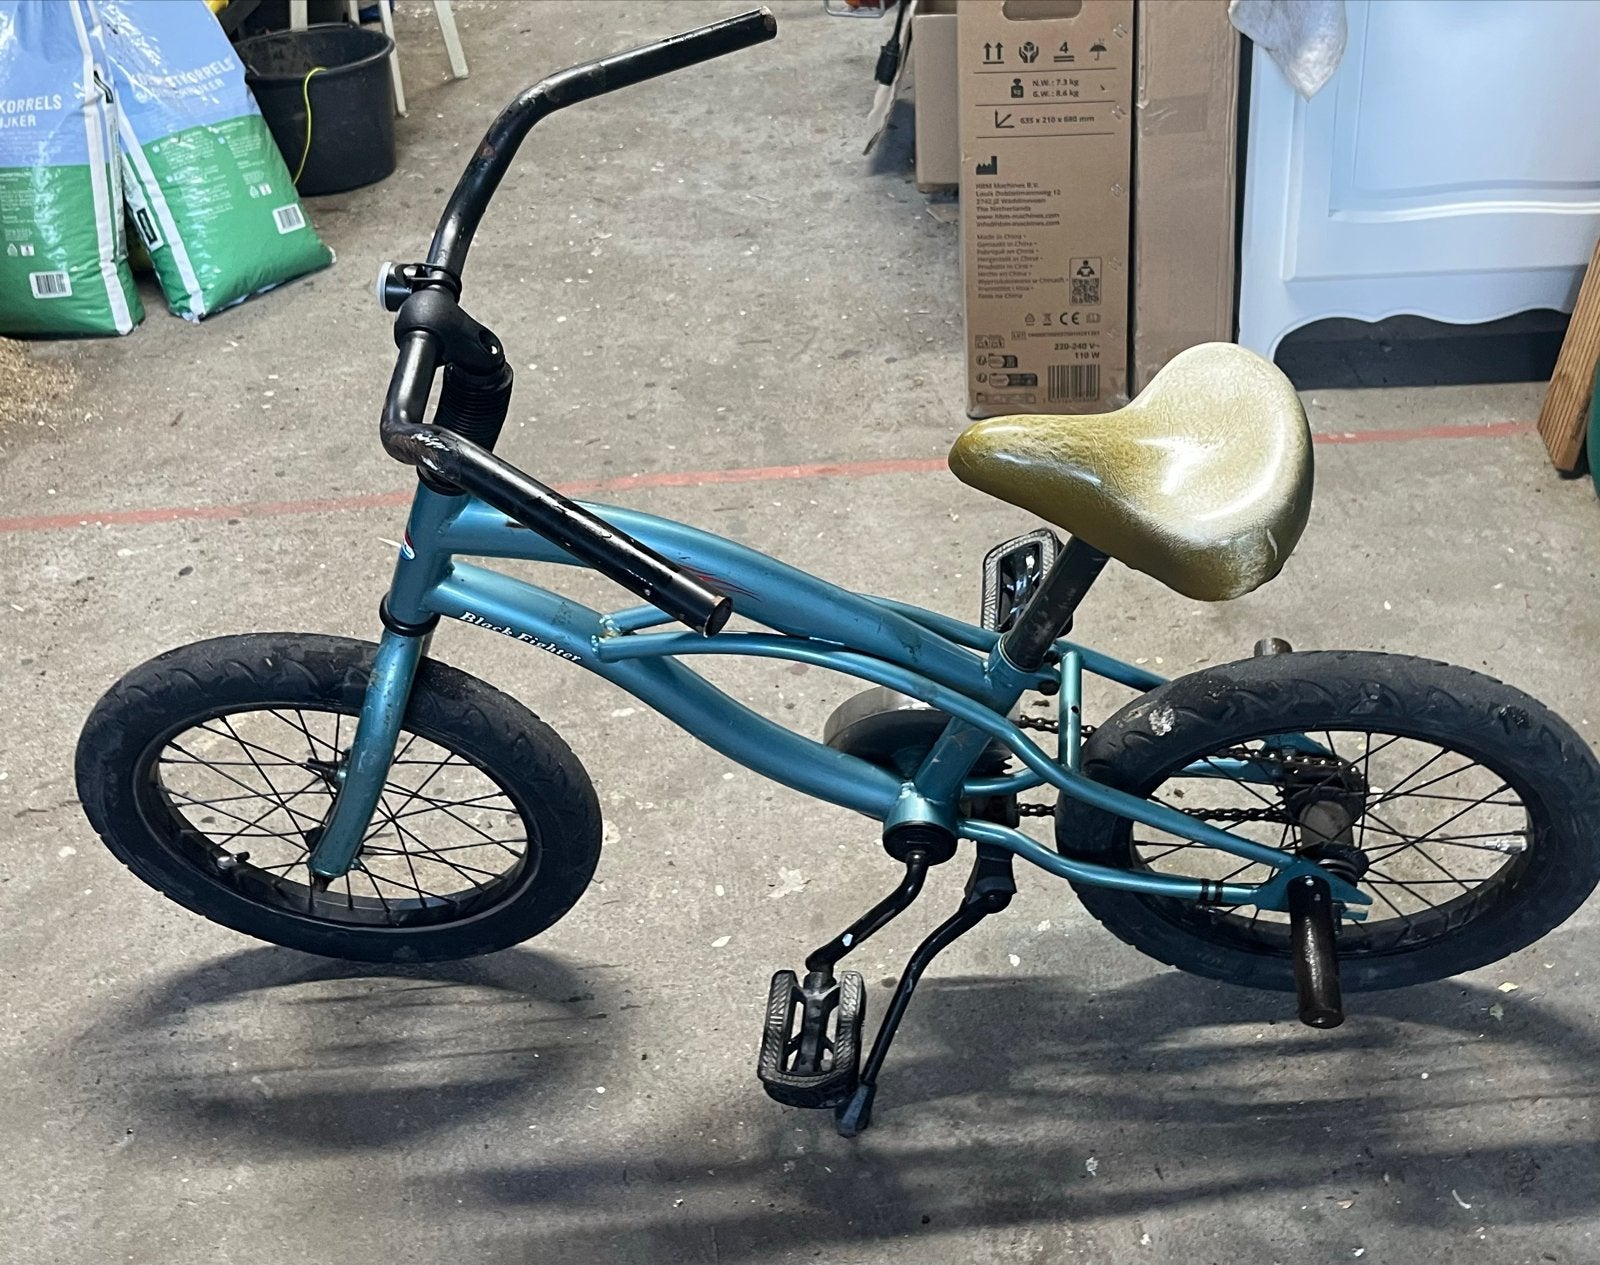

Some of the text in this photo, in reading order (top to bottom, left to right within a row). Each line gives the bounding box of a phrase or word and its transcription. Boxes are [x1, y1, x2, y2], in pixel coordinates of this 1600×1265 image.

[1060, 41, 1069, 54] 4
[1069, 78, 1079, 87] kg
[1069, 89, 1079, 98] kg
[1020, 117, 1034, 125] 635
[1079, 115, 1095, 123] mm
[459, 611, 582, 661] Black Fighter
